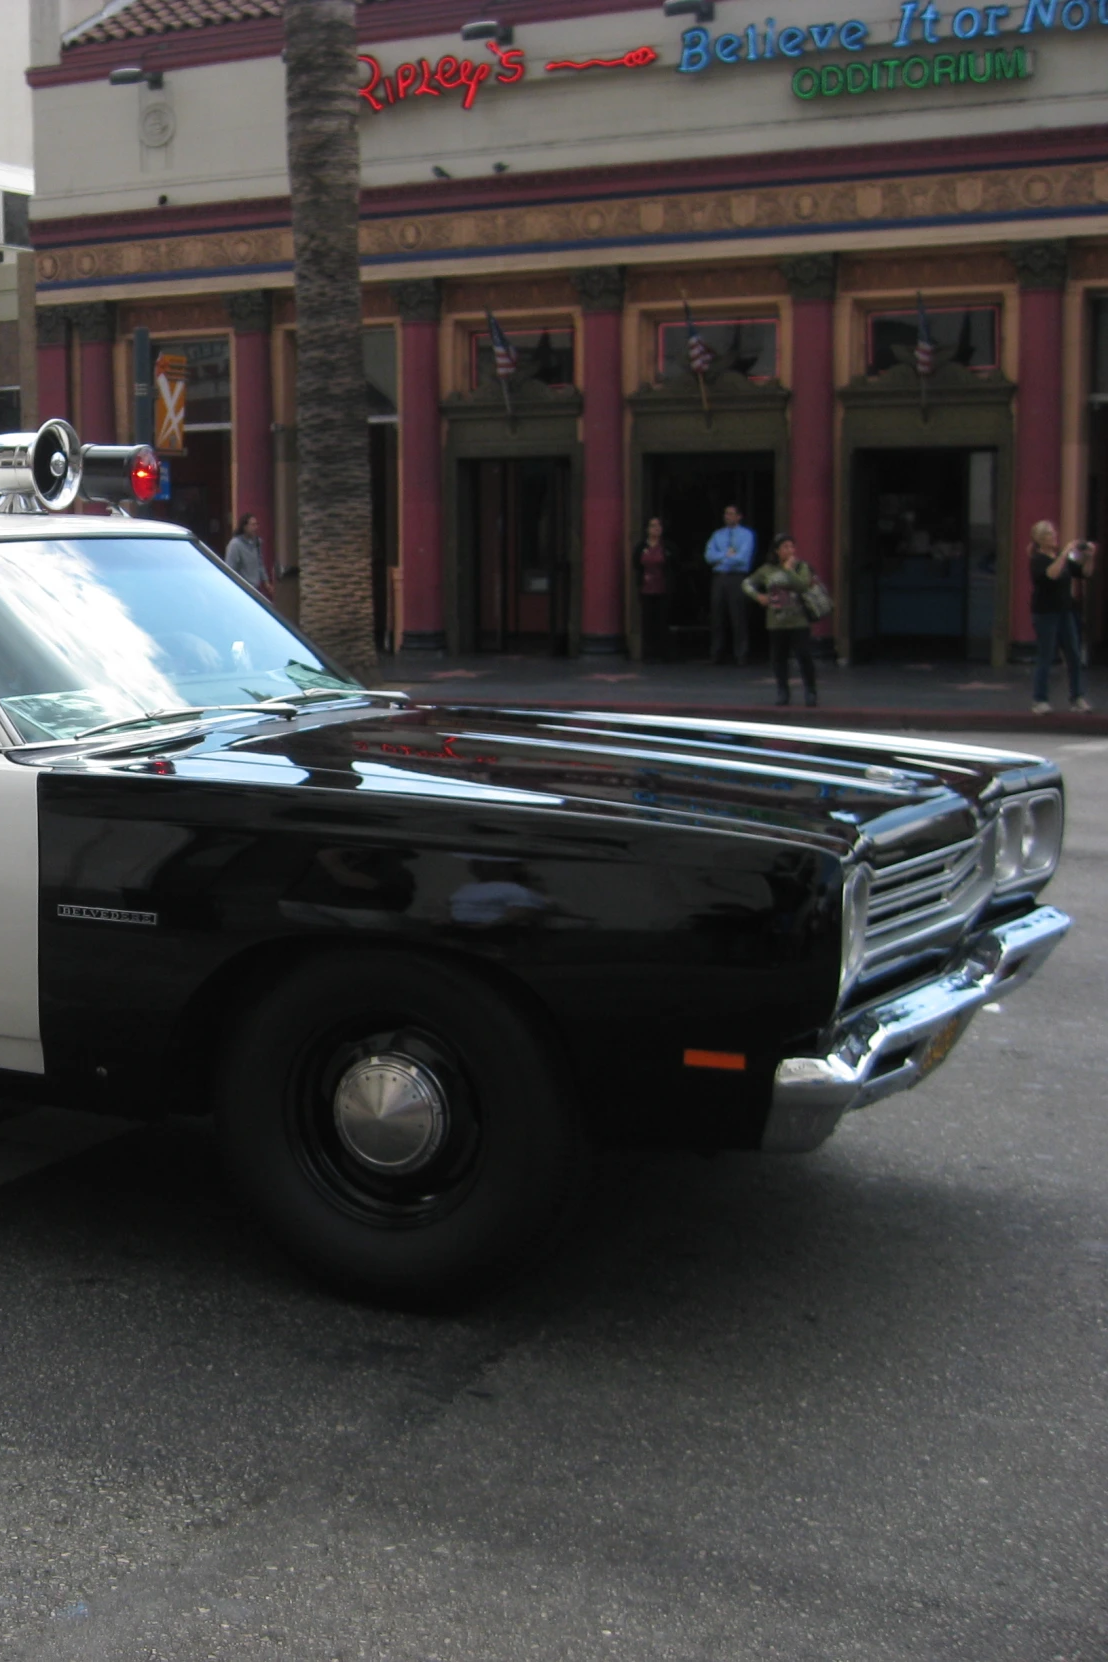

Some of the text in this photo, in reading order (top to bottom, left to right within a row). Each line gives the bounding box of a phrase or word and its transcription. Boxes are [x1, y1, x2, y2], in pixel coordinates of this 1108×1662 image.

[678, 18, 868, 74] Believe
[893, 1, 940, 48] It
[952, 6, 1010, 39] or
[792, 46, 1029, 100] ODDITORIUM
[61, 905, 153, 924] BELVEDERE
